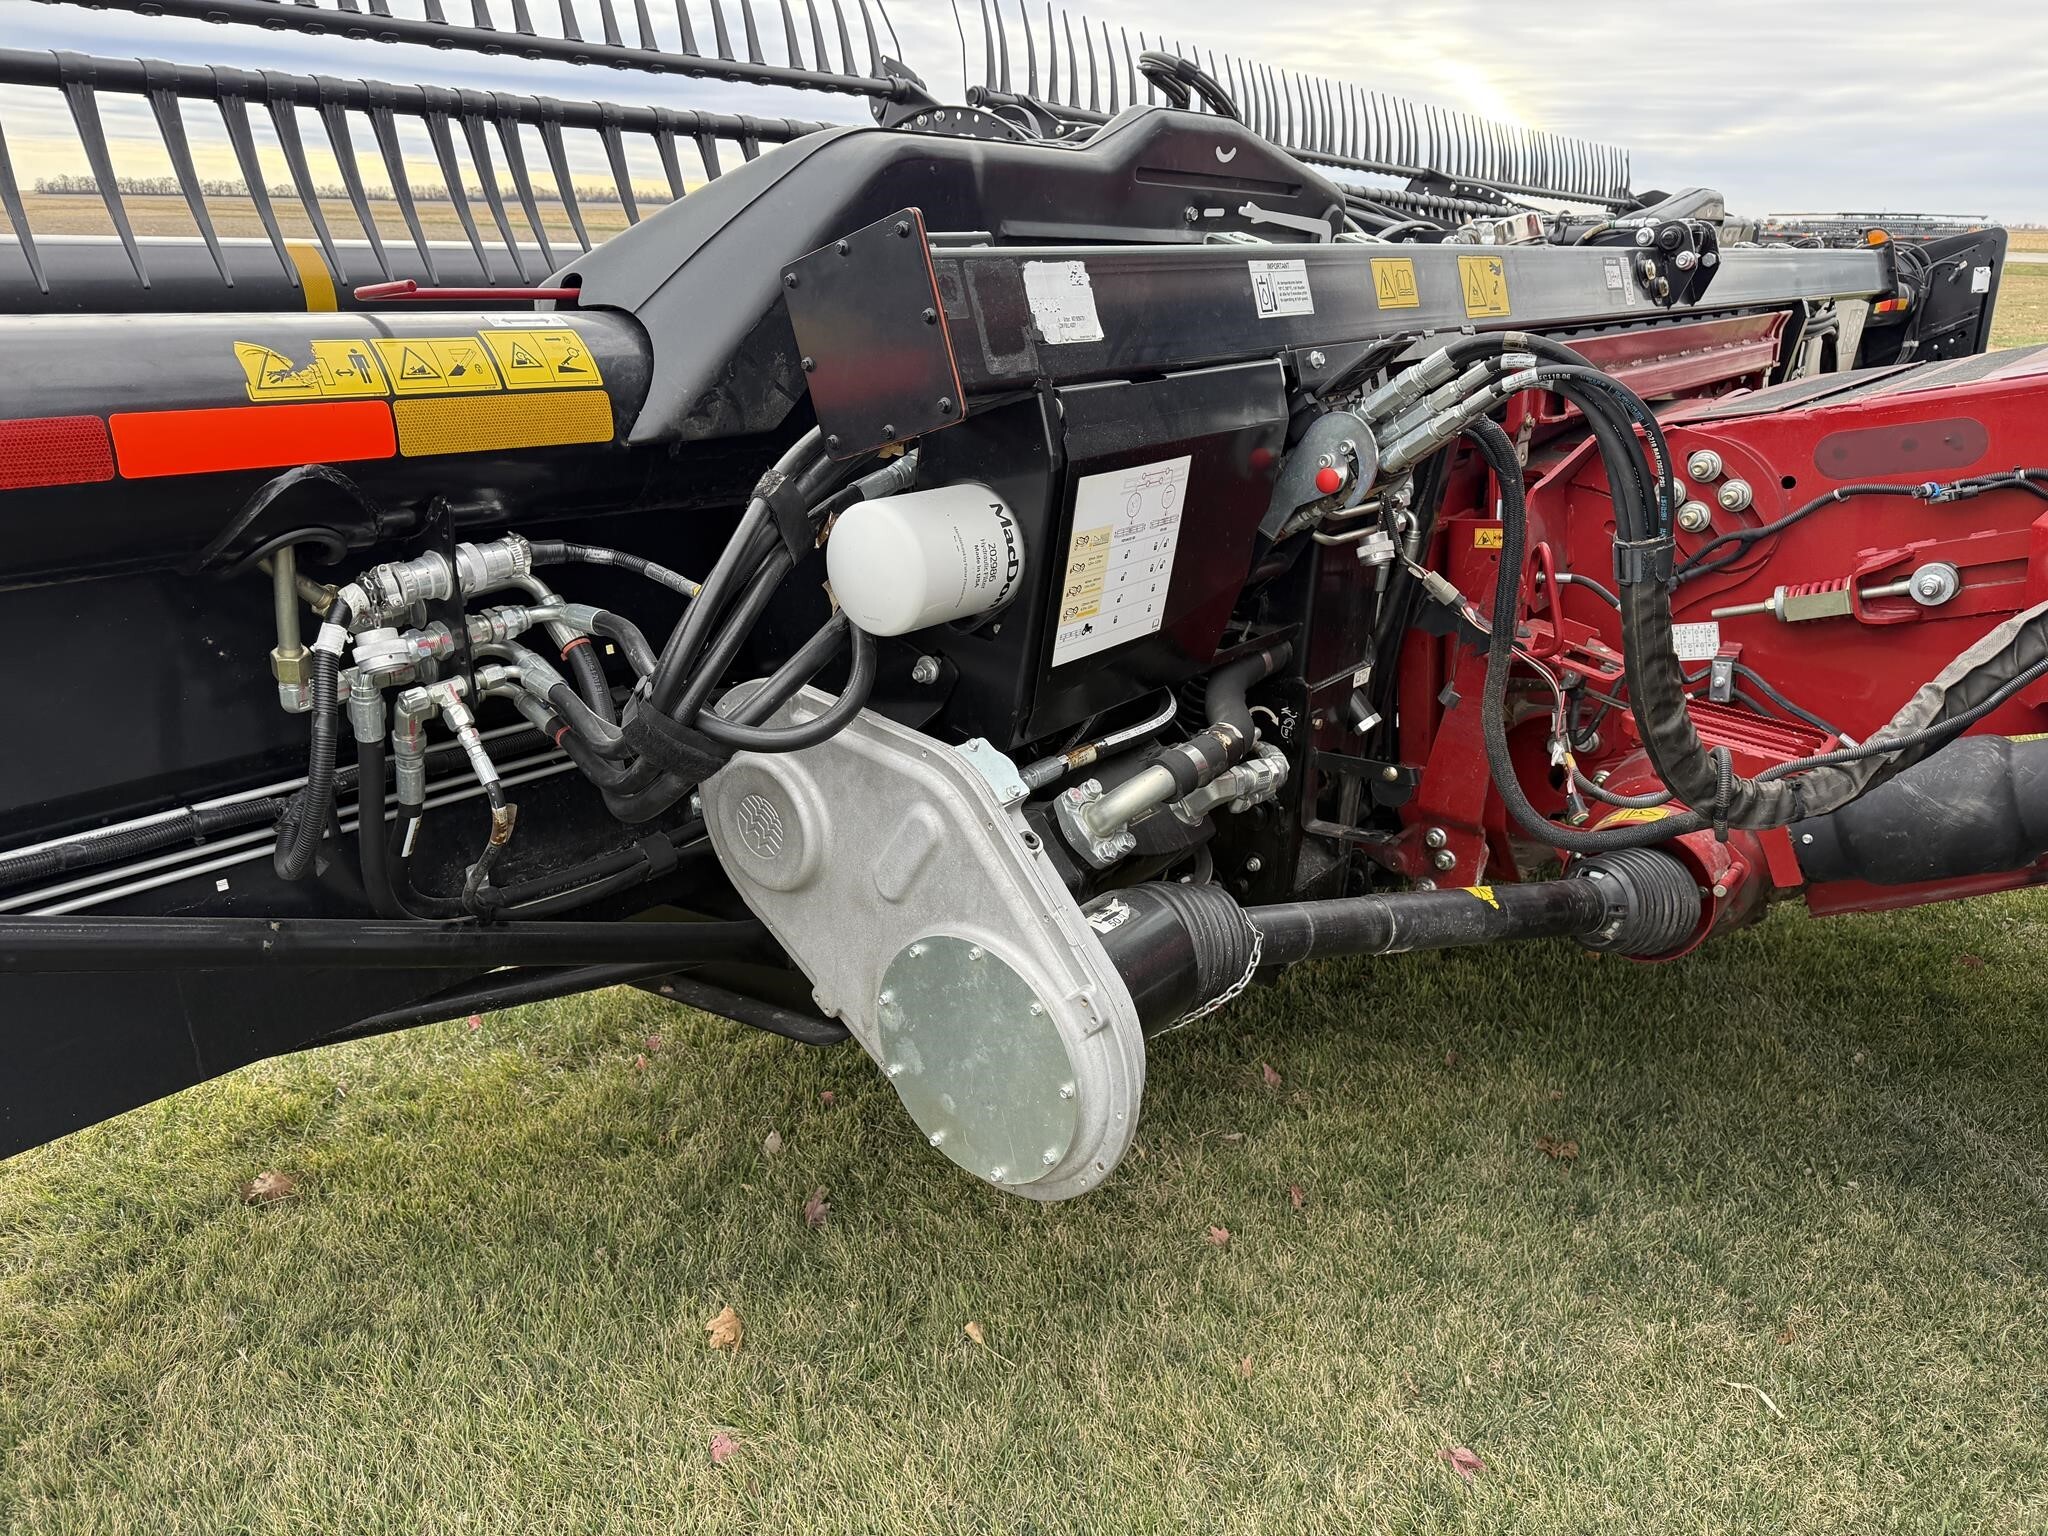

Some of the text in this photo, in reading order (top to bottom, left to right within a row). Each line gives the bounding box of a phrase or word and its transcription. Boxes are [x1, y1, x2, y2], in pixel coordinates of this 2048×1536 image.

[1267, 262, 1289, 270] IMPORTANT
[980, 538, 988, 570] Hydraulic
[988, 543, 998, 583] 202986
